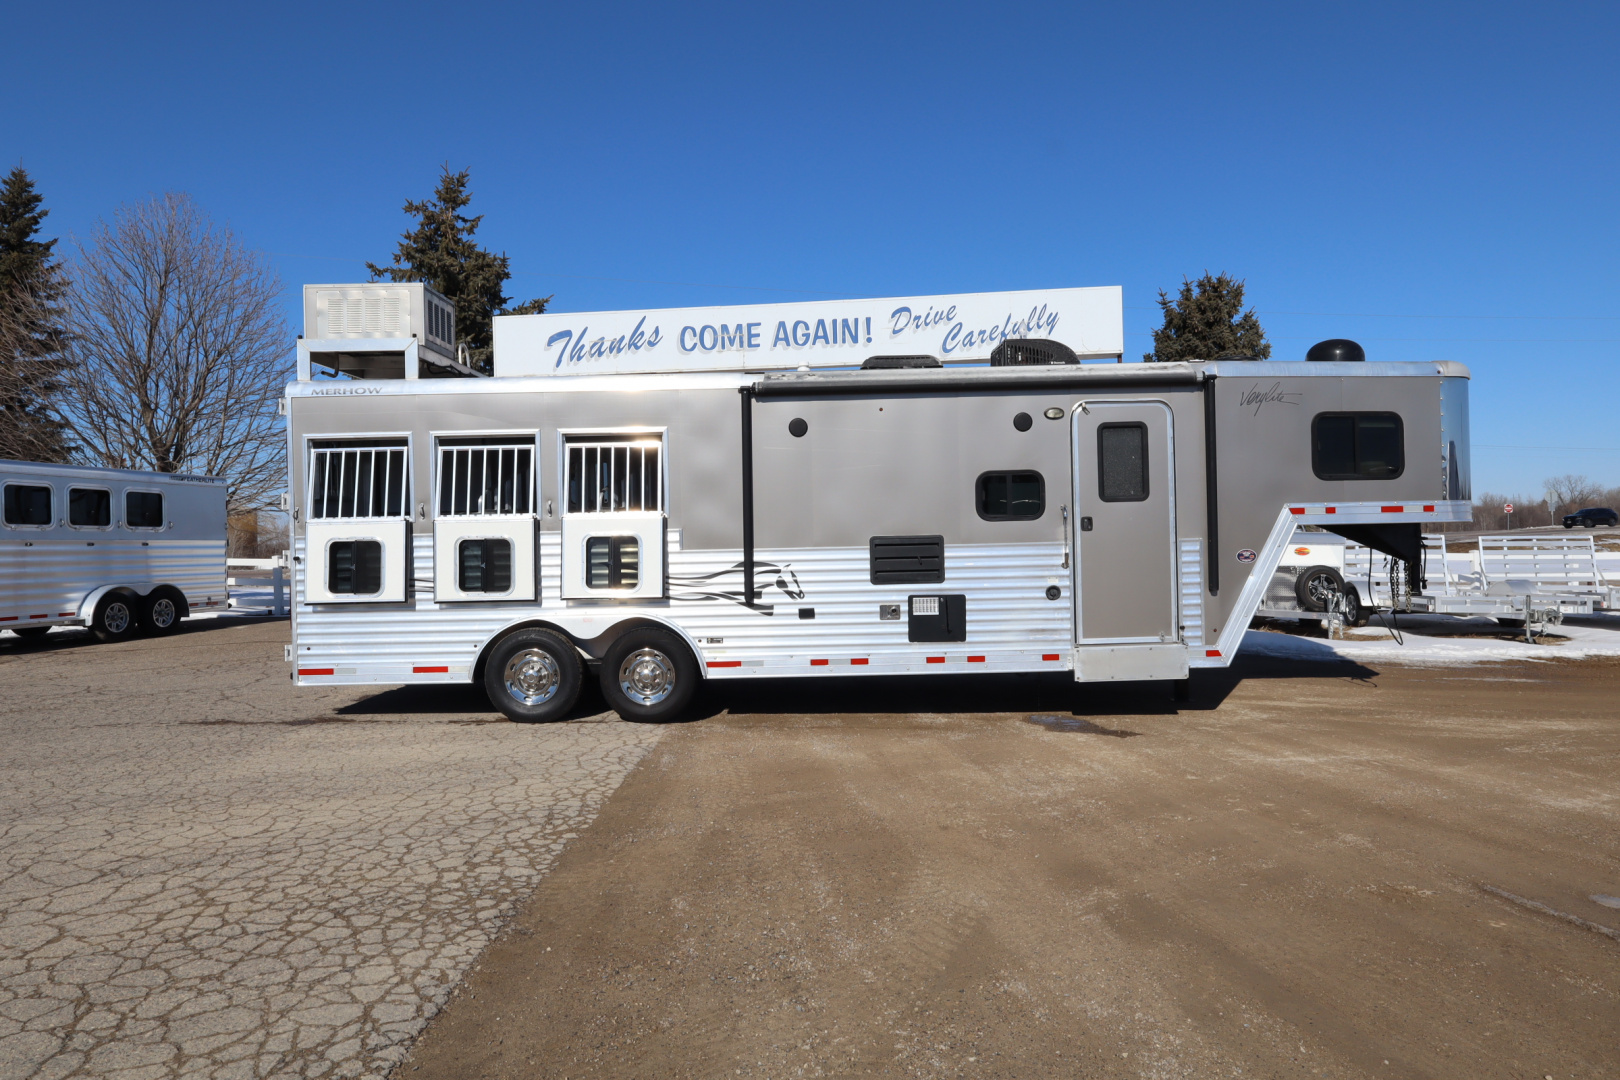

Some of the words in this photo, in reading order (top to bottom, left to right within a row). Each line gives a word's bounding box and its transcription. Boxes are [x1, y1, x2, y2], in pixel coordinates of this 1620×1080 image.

[890, 304, 958, 335] Drive
[941, 302, 1061, 354] Carefully
[546, 315, 664, 369] Thanks
[679, 322, 762, 352] COME
[772, 316, 873, 348] AGAIN!
[311, 386, 383, 396] MERHOW
